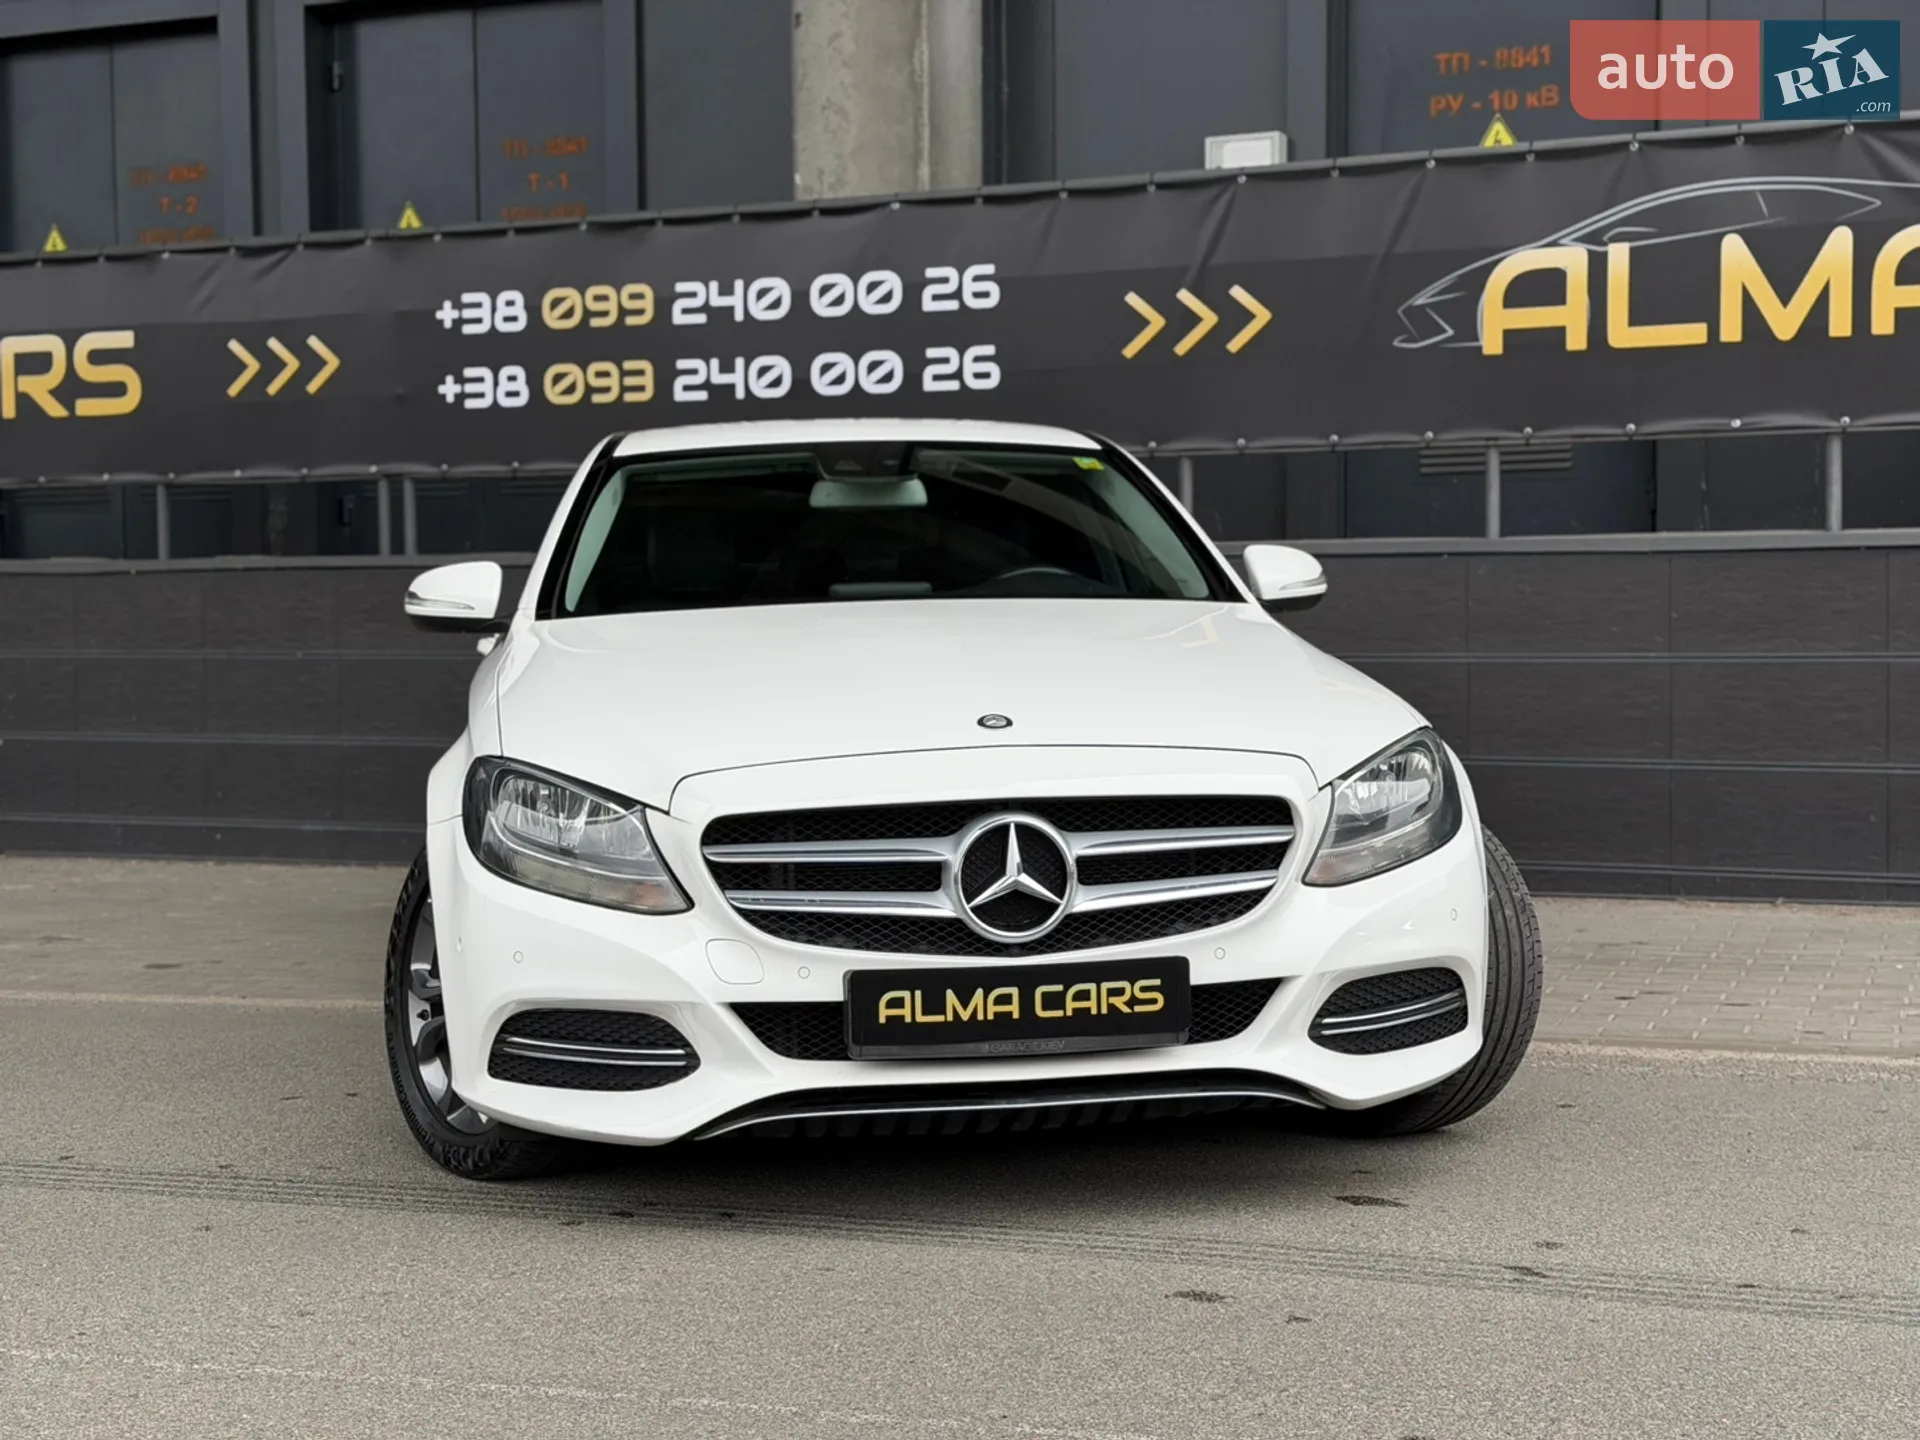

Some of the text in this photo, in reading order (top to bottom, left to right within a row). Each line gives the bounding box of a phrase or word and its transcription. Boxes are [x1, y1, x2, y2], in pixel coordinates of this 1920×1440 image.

[1488, 88, 1518, 111] 10
[435, 263, 1000, 334] +38 099 240 00 26
[0, 330, 142, 419] RS
[437, 344, 1000, 409] +38 093 240 00 26
[879, 979, 1165, 1023] ALMA CARS
